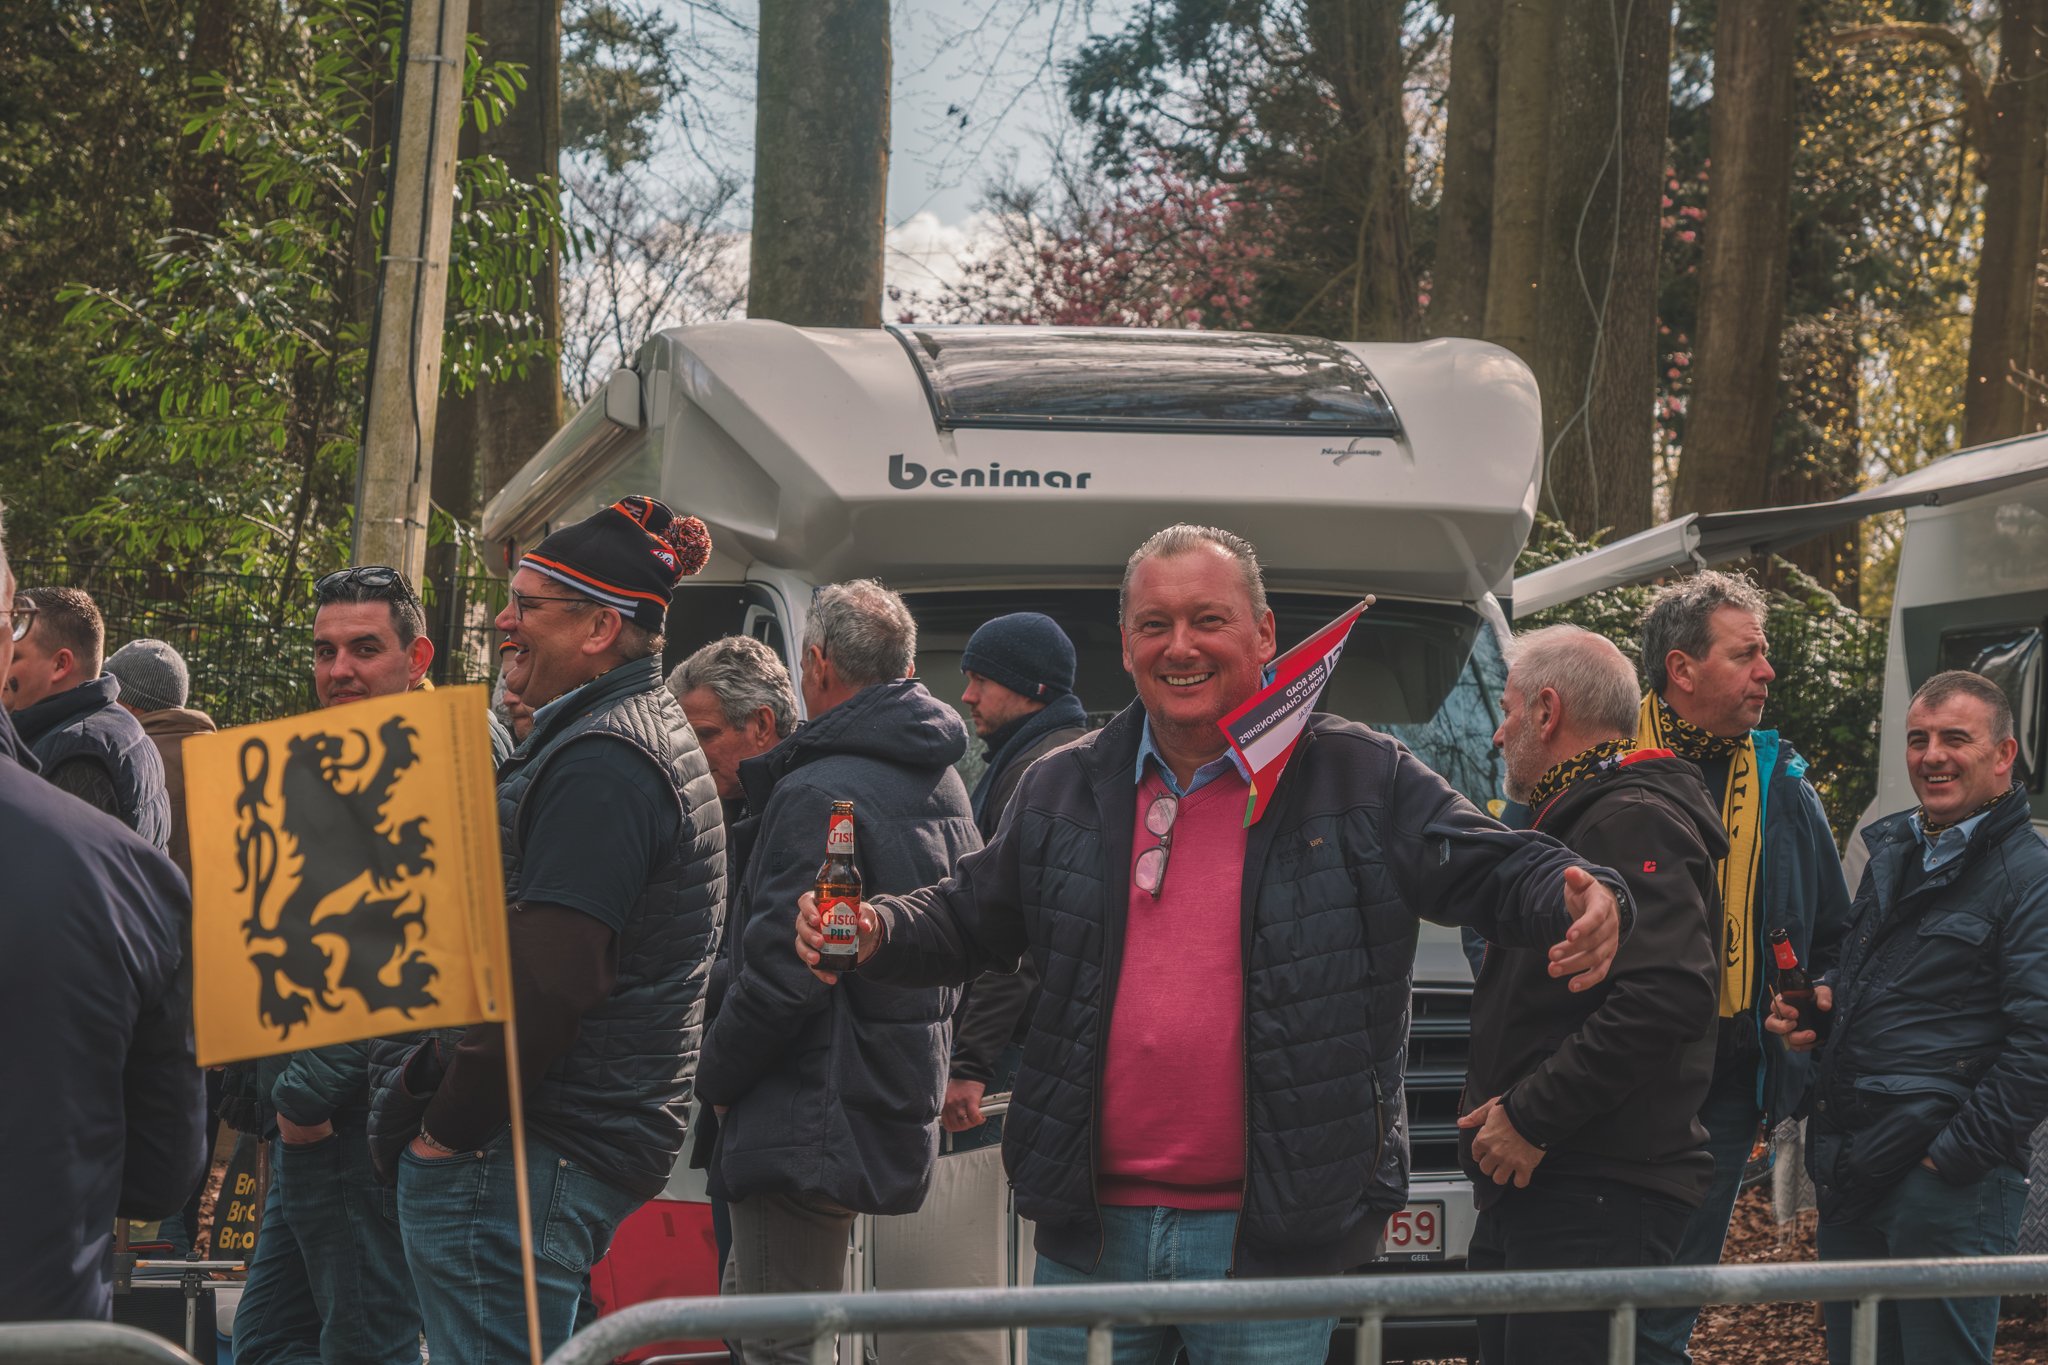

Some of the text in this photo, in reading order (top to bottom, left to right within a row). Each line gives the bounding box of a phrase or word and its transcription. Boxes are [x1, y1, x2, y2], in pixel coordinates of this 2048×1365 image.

[888, 454, 1092, 489] benimar
[829, 828, 854, 845] Crist
[820, 909, 859, 927] Crista
[830, 928, 851, 941] PILS
[1384, 1211, 1435, 1247] 59
[1411, 1254, 1430, 1262] GEEL
